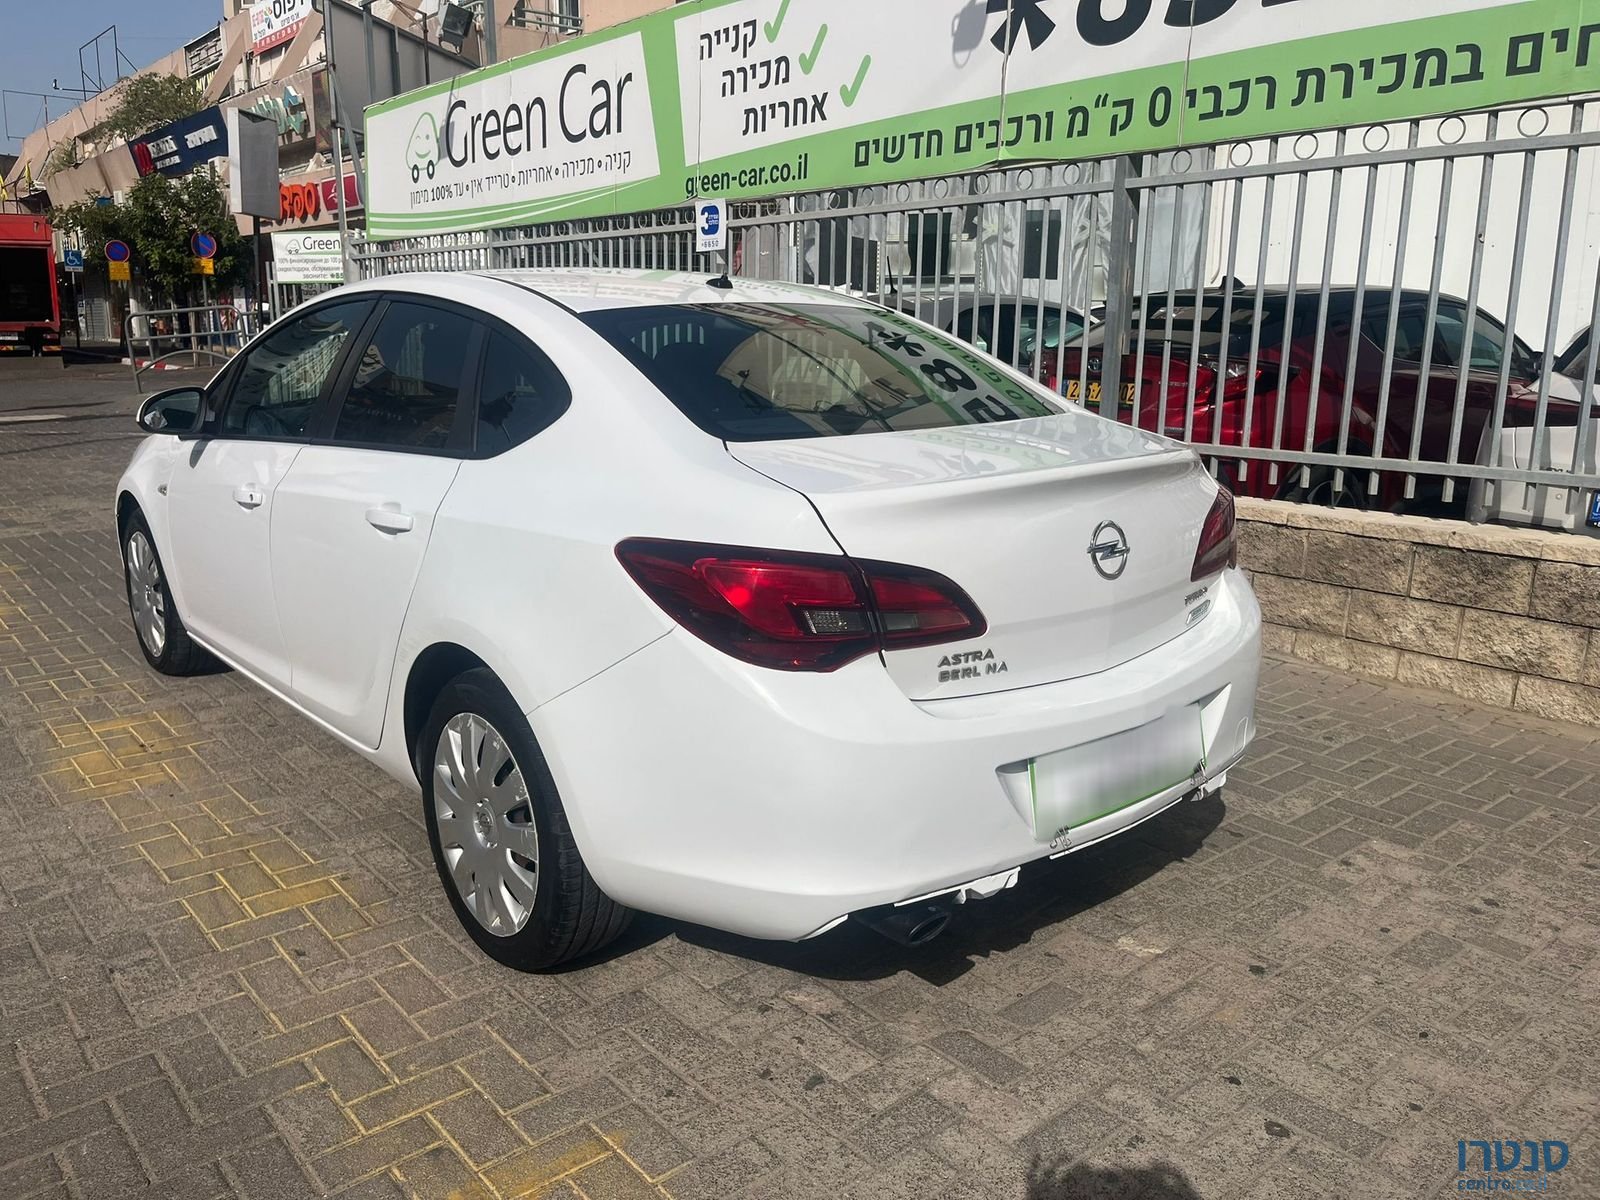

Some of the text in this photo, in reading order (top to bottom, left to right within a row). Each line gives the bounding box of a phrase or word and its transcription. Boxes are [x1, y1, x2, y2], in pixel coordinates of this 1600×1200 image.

[700, 19, 757, 60] קנייה
[721, 55, 790, 98] מכירה
[1291, 43, 1484, 107] במכירת
[446, 63, 633, 168] Green Car
[742, 91, 829, 136] אחריות
[1185, 75, 1277, 121] רכבי
[854, 128, 943, 168] חדשים
[954, 110, 1054, 154] ורכבים
[485, 172, 510, 192] טרייד
[518, 165, 552, 185] אחריות
[562, 158, 594, 179] מכירה
[604, 150, 631, 175] קניה
[685, 153, 808, 199] green-car.co.il
[410, 189, 429, 209] מימון
[431, 183, 453, 203] 100%
[303, 236, 341, 250] Green
[937, 648, 994, 668] ASTRA
